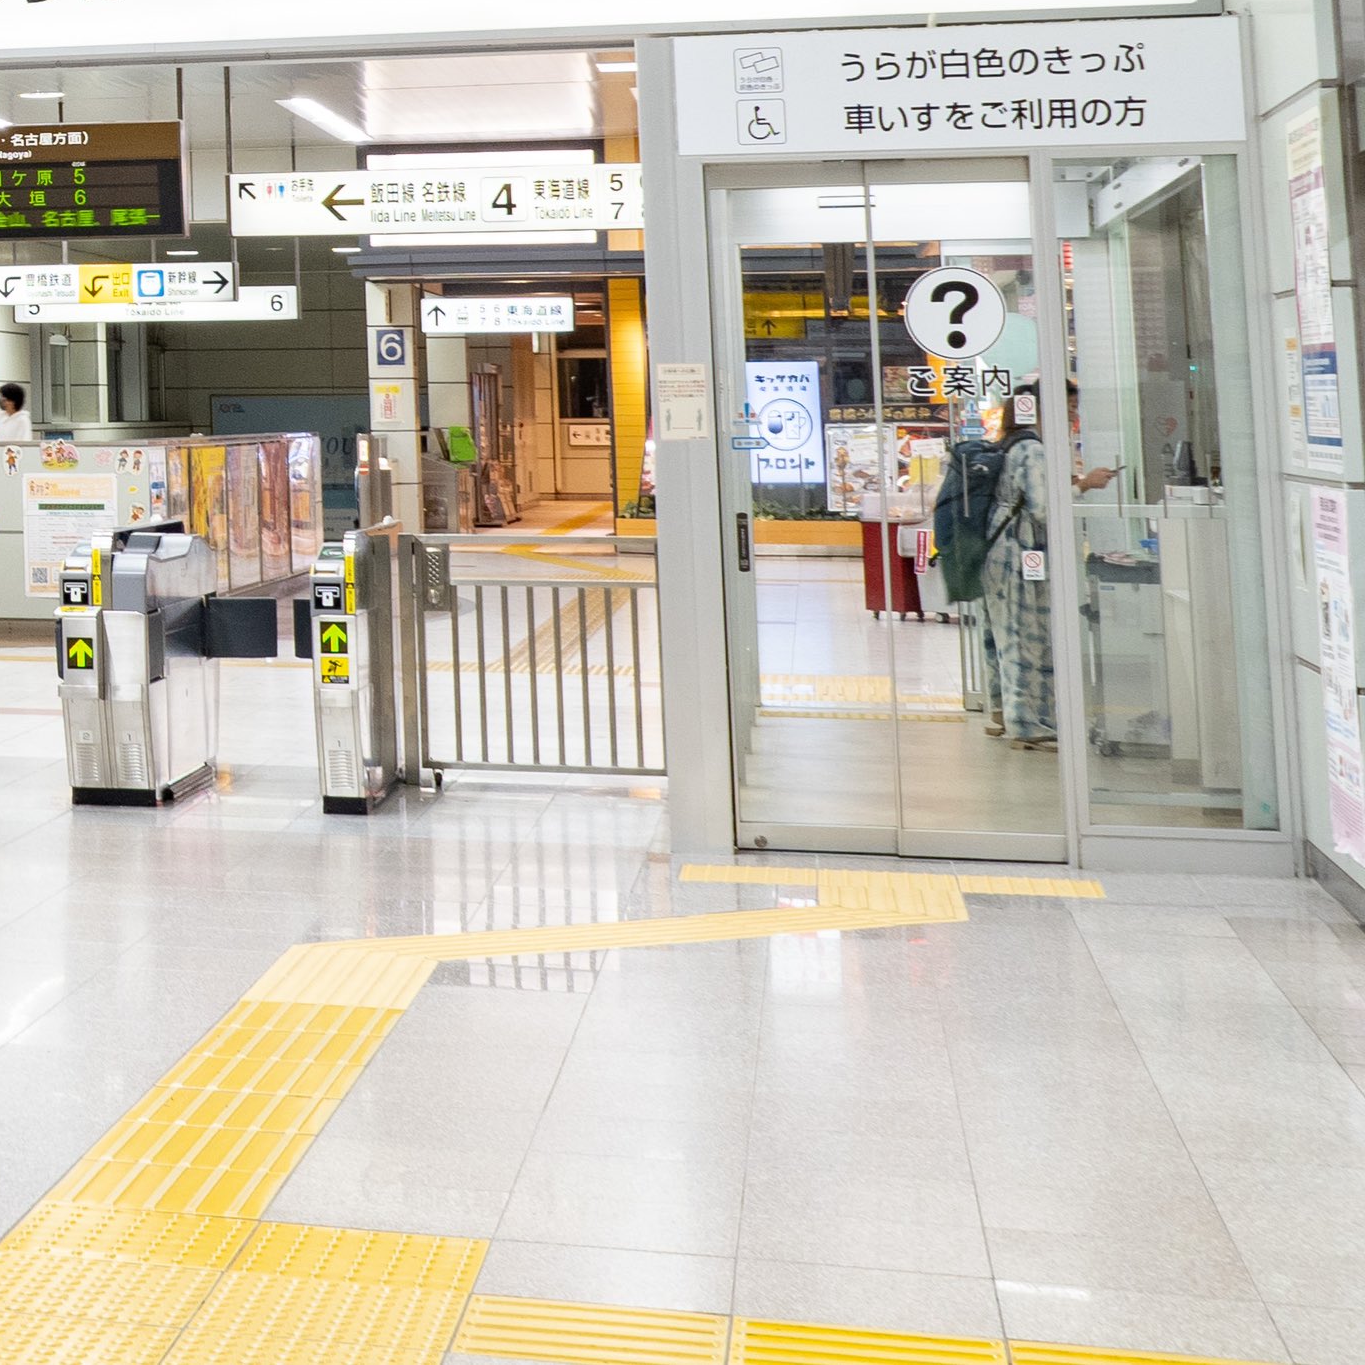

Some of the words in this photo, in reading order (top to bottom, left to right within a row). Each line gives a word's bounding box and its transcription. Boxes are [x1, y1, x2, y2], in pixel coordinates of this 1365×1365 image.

[841, 44, 1146, 82] うらが白色のきっぷ
[843, 97, 1147, 134] 車いすをご利用の方
[73, 168, 85, 185] 5
[74, 189, 87, 206] 6
[370, 181, 416, 204] 飯田線
[422, 181, 466, 203] 名鉄線
[491, 183, 517, 216] 4
[533, 178, 590, 200] 東海道線
[609, 173, 623, 192] 5
[370, 210, 390, 223] Iida
[393, 209, 417, 223] Line
[421, 208, 456, 223] Meitetsu
[458, 208, 476, 222] Line
[573, 205, 593, 219] Line
[610, 202, 625, 220] 7
[112, 272, 130, 286] 出口
[113, 288, 130, 297] Exit
[270, 294, 284, 312] 6
[380, 333, 402, 362] 6
[907, 365, 1012, 398] ご案内
